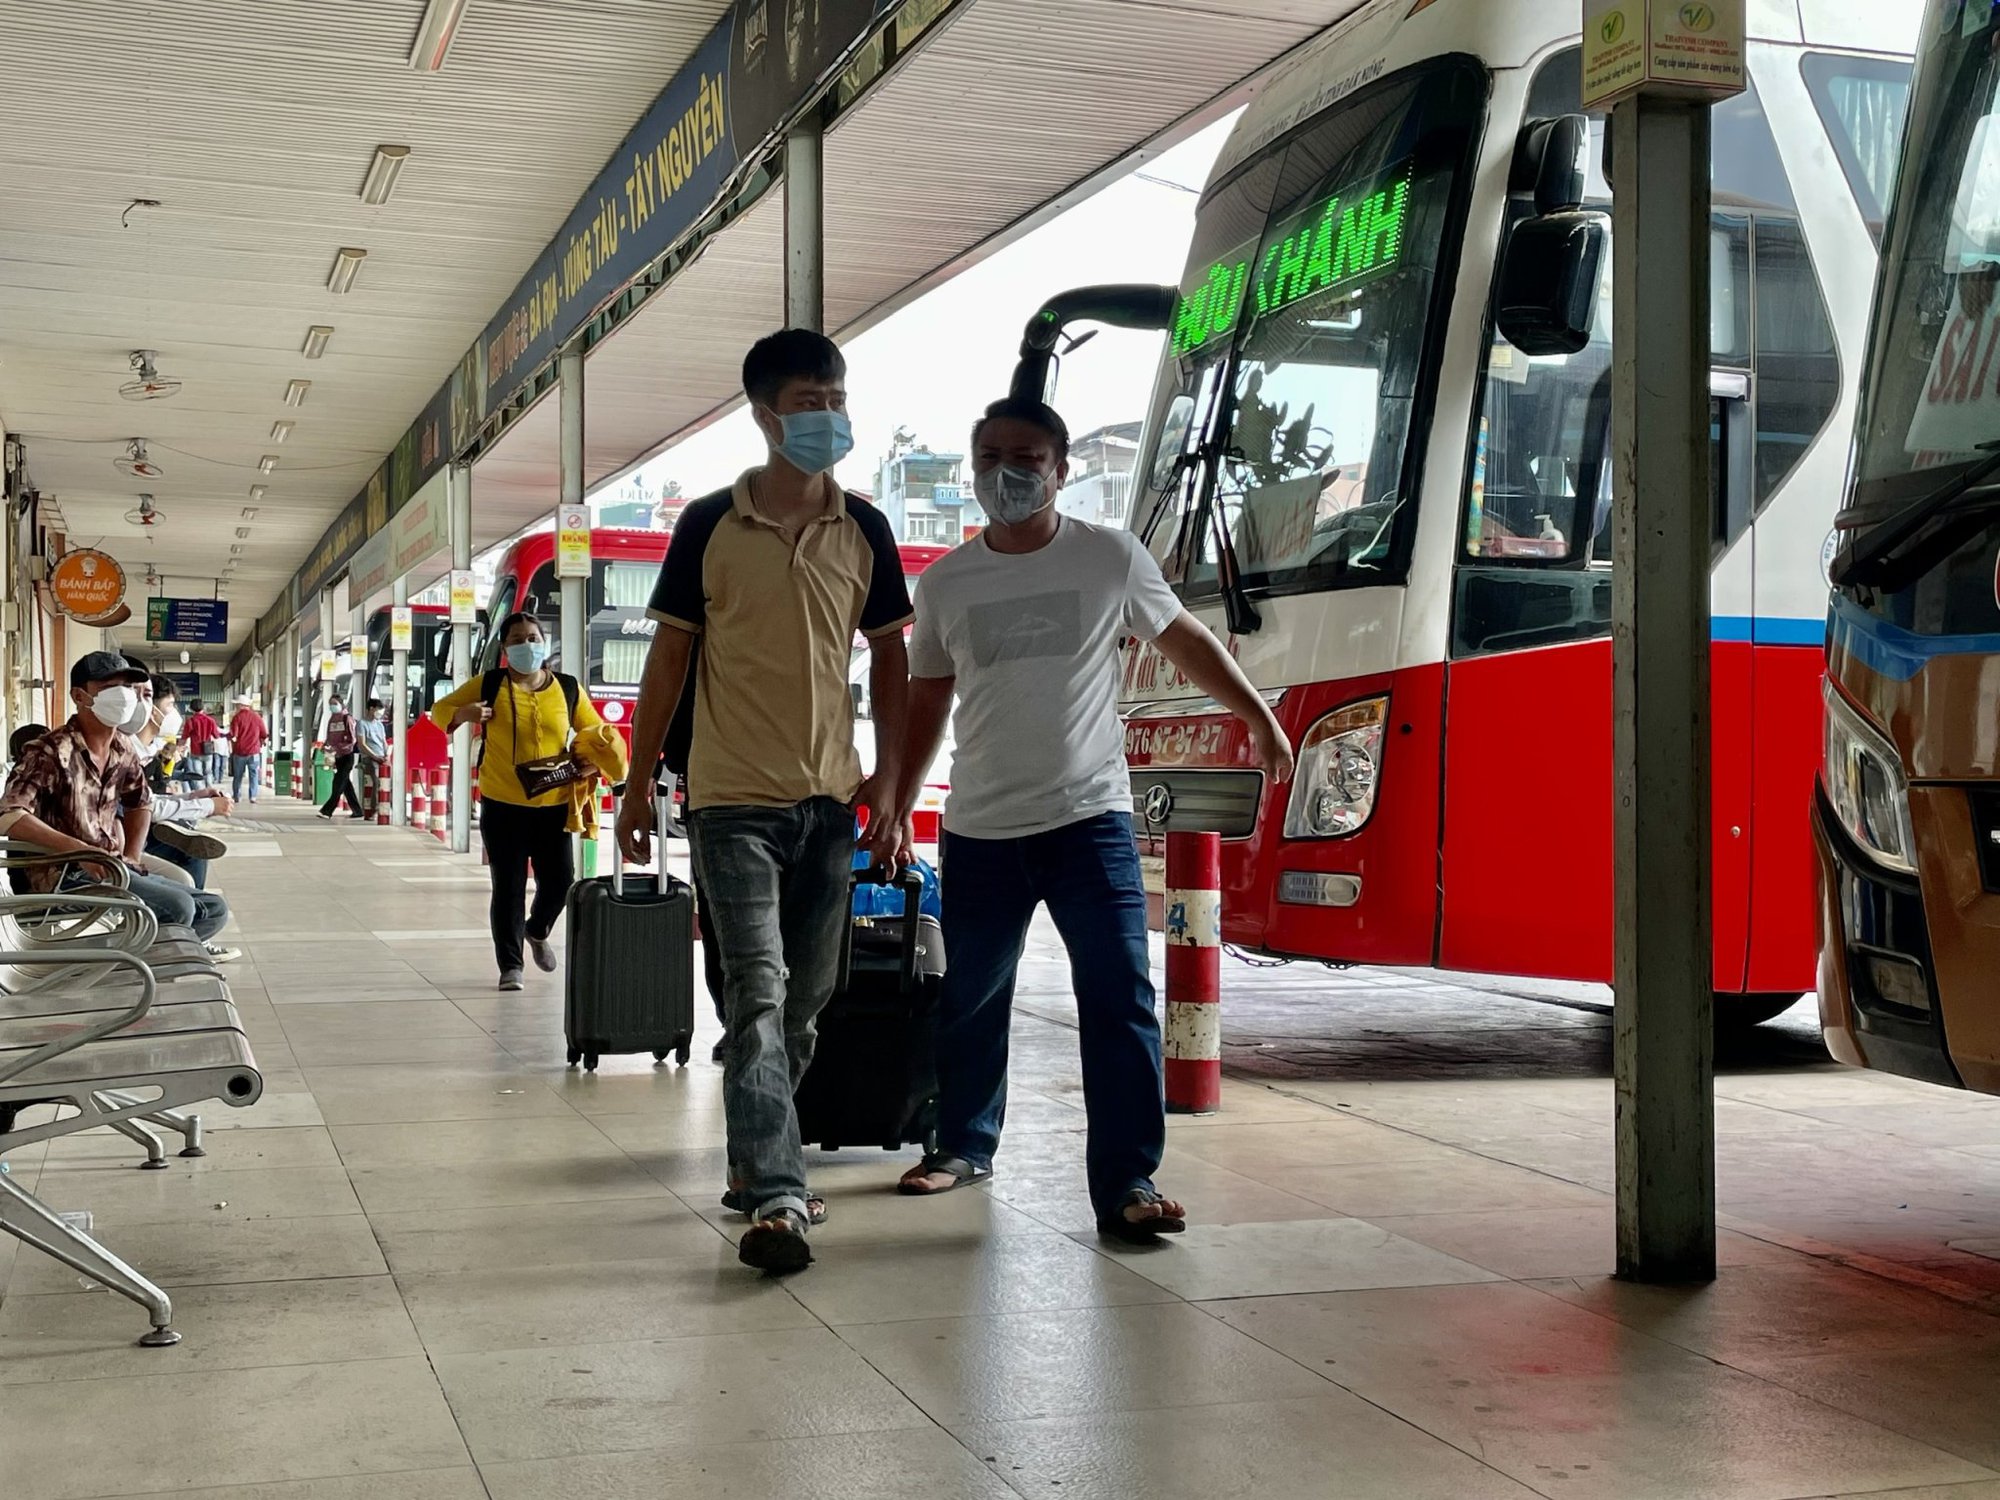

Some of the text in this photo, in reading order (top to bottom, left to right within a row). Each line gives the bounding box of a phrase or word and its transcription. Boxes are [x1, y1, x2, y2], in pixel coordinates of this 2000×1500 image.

[1697, 37, 1728, 48] COMPANY
[564, 229, 592, 303] VŨNG
[592, 198, 618, 270] TÀU
[625, 152, 655, 235] TÂY
[656, 72, 725, 204] NGUYÊN
[60, 577, 91, 591] BÁNH
[86, 591, 110, 603] QUỐC
[151, 619, 162, 637] 2
[1168, 902, 1188, 944] 4
